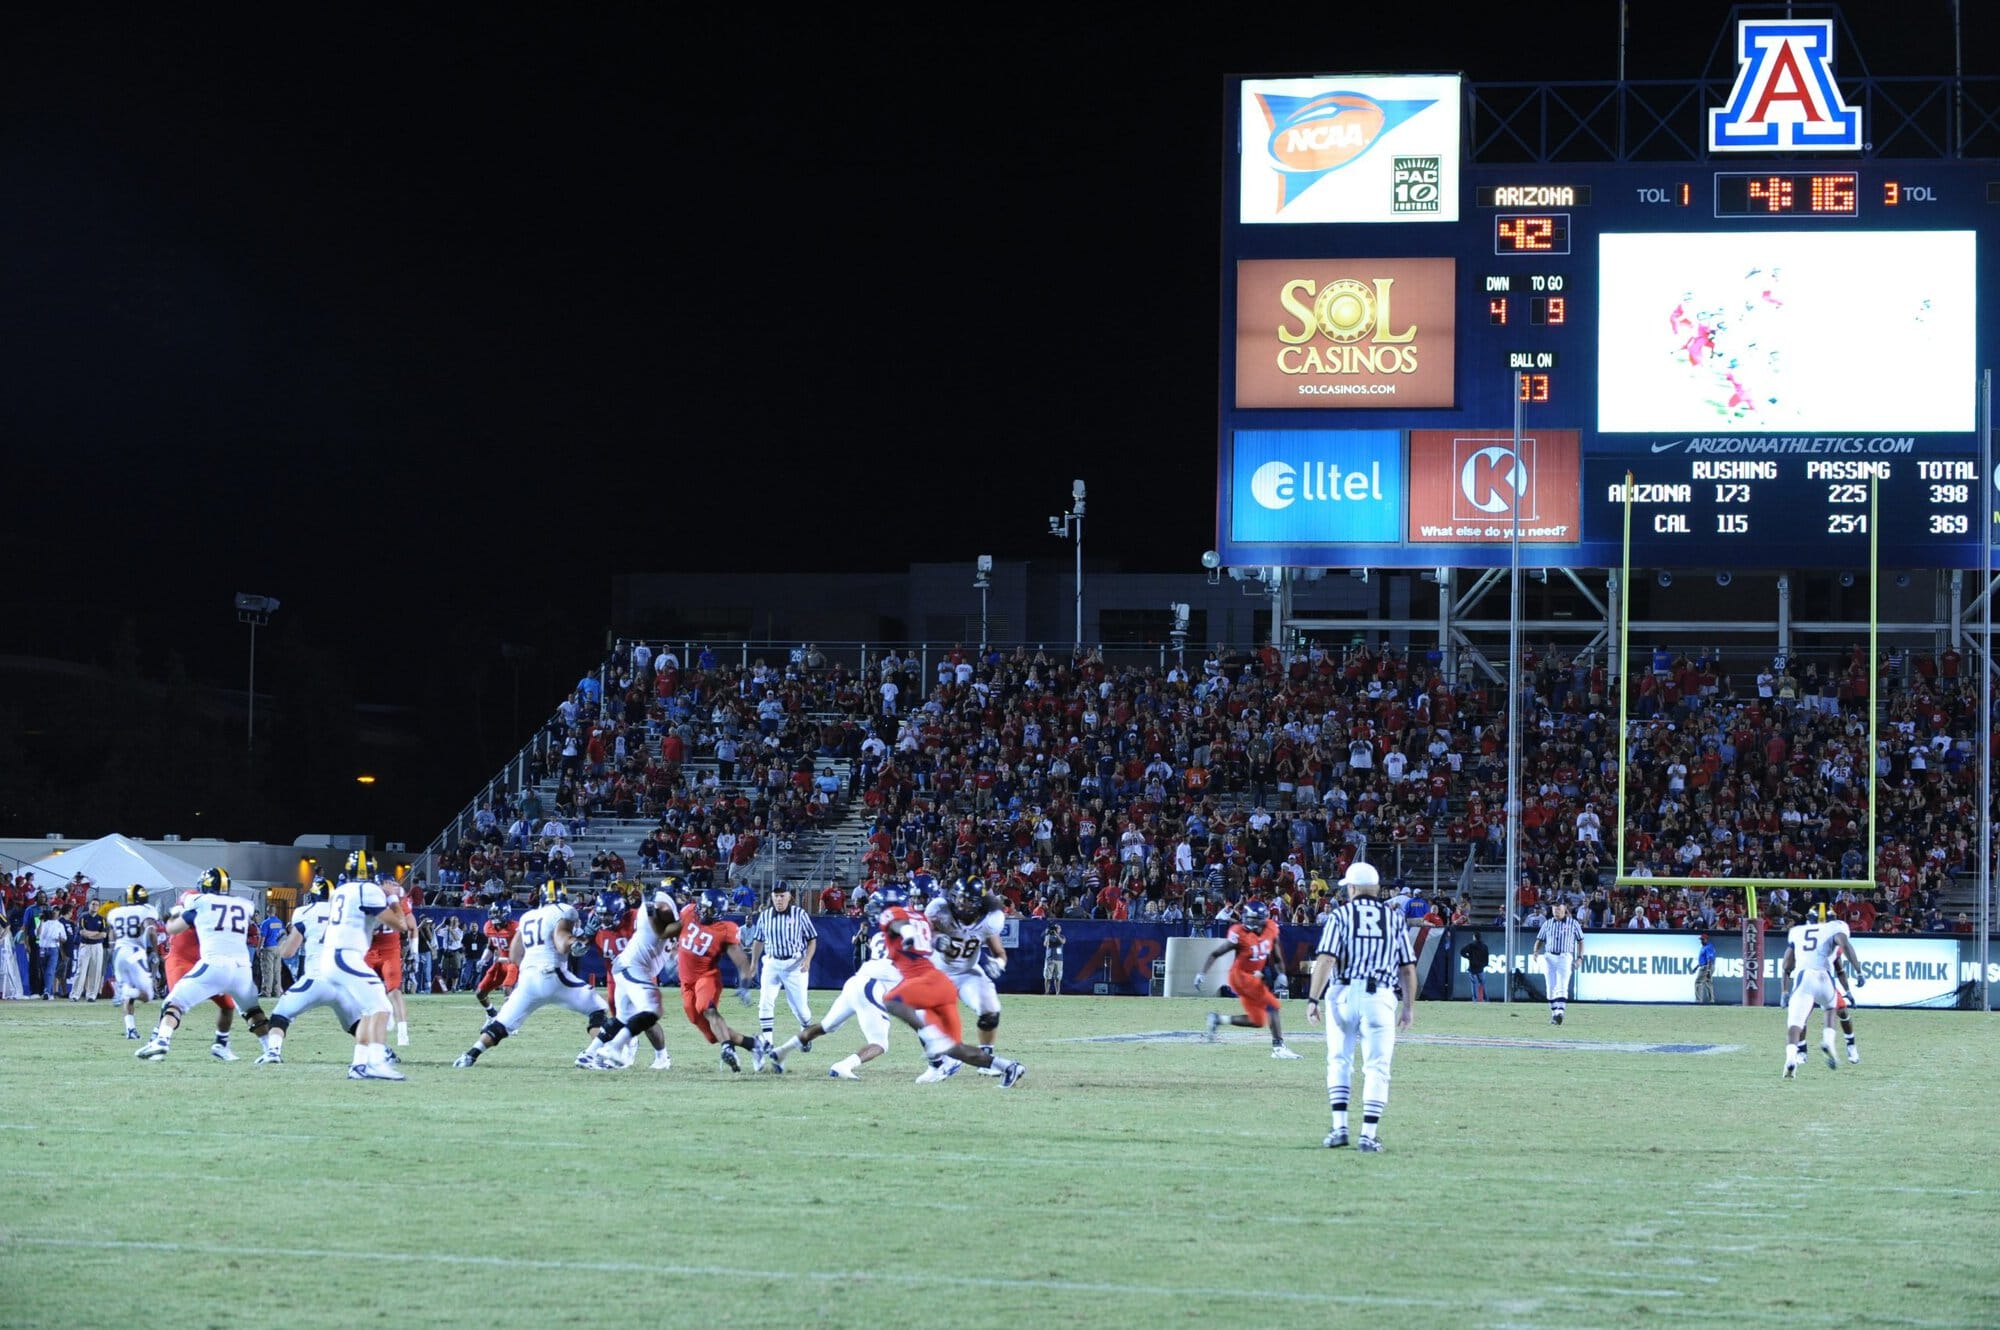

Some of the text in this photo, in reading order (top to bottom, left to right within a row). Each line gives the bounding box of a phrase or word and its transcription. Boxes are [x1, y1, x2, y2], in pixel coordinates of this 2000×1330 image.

[1709, 20, 1862, 152] A
[1286, 122, 1365, 154] NCAA
[1395, 170, 1438, 183] PAC
[1395, 183, 1438, 202] 10
[1494, 187, 1574, 207] ARIZONA
[1637, 188, 1671, 203] TOL
[1682, 184, 1689, 206] 1
[1884, 183, 1899, 206] 3
[1903, 186, 1937, 202] TOL
[1499, 218, 1553, 249] 42
[1486, 276, 1510, 291] DWN
[1531, 276, 1563, 291] TO GO
[1277, 278, 1418, 344] SOL
[1490, 298, 1507, 324] 4
[1548, 298, 1564, 324] 9
[1276, 345, 1418, 376] CASINOS
[1510, 353, 1552, 368] BALL ON
[1298, 384, 1396, 395] SOLCASINOS.COM
[1684, 437, 1915, 454] ARIZONAATHLETICS.COM
[1473, 452, 1520, 506] K
[1692, 461, 1979, 480] RUSHING PASSING TOTAL
[1273, 460, 1383, 502] alltel
[1608, 484, 1968, 503] ARIZONA 173 225 398
[1421, 526, 1453, 536] What
[1456, 527, 1481, 536] else
[1485, 526, 1500, 536] do
[1654, 514, 1968, 533] CAL 115 251 369
[791, 650, 802, 662] 26
[1774, 657, 1786, 669] 28
[777, 840, 793, 850] 26
[211, 904, 246, 934] 72
[1357, 906, 1382, 938] R
[523, 918, 545, 949] 51
[681, 922, 714, 957] 33
[1803, 929, 1819, 951] 5
[1581, 954, 1695, 975] MUSCLE MILK
[1745, 923, 1759, 990] ARIZONA
[1904, 961, 1948, 981] MILK
